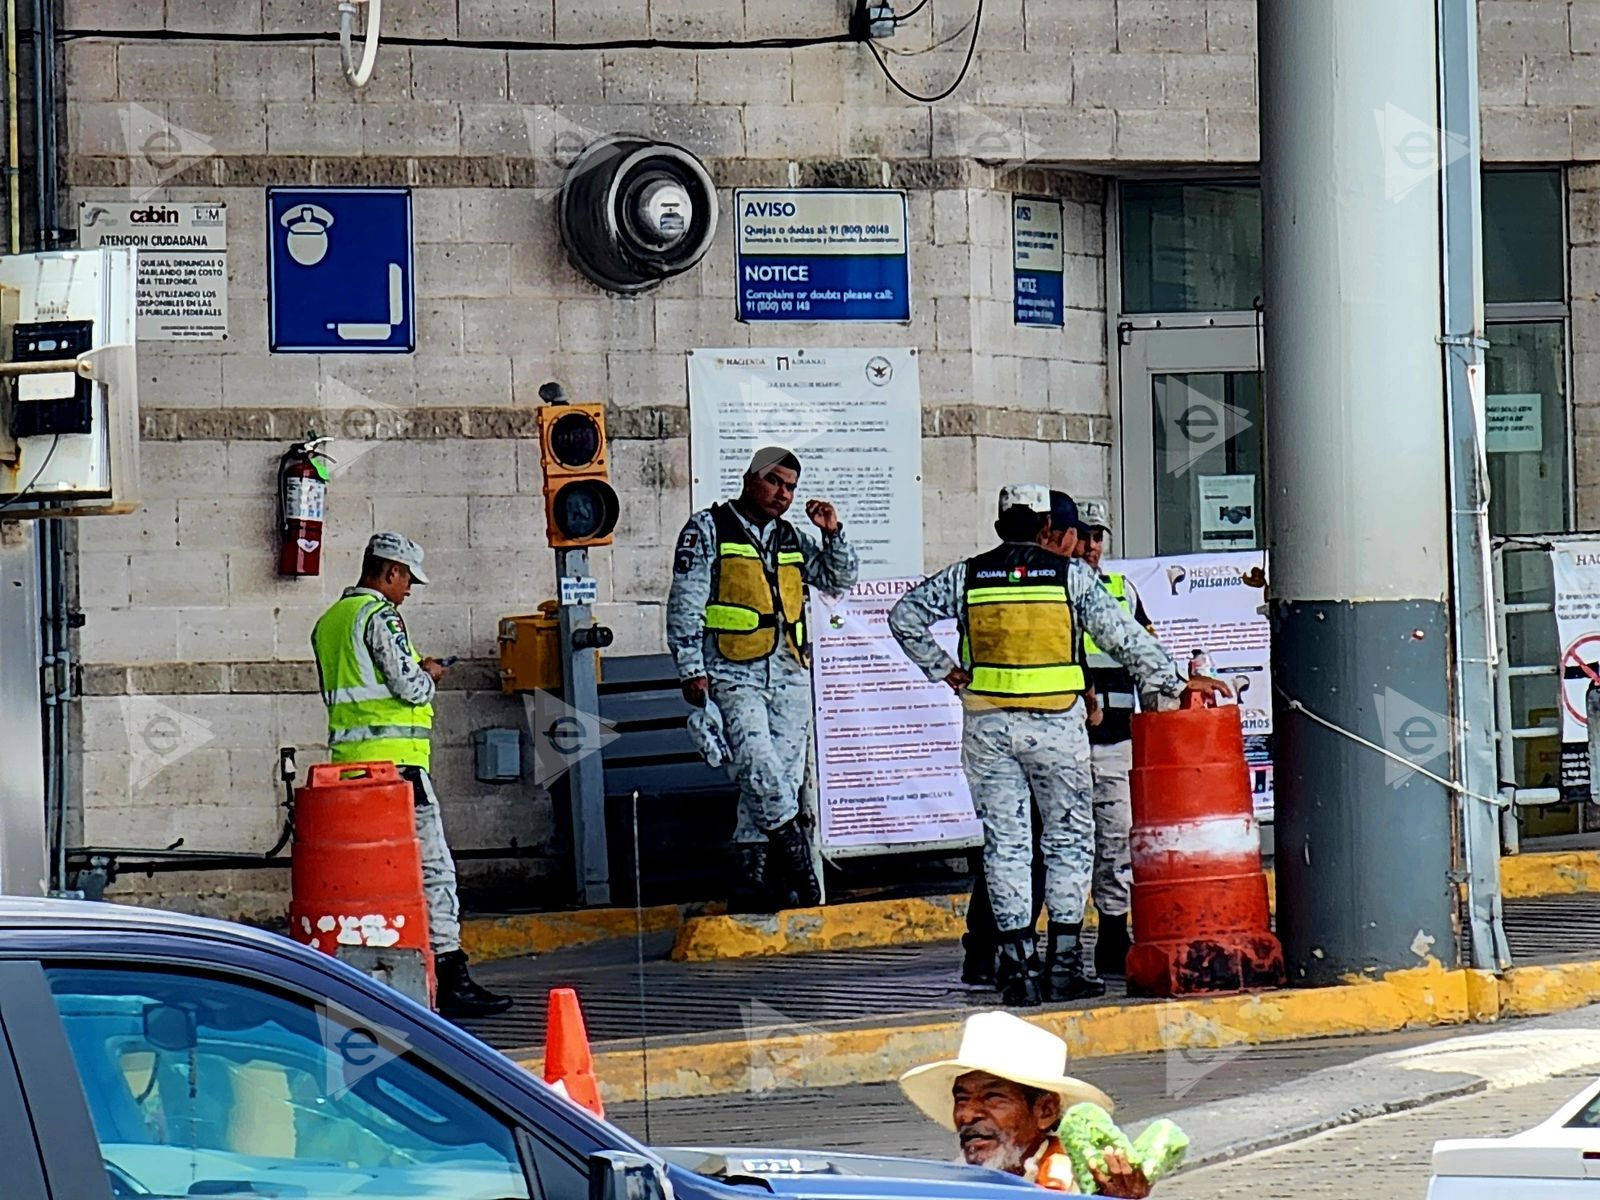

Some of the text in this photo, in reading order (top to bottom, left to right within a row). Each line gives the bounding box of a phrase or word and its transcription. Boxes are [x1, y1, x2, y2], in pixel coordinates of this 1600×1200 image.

[130, 206, 179, 223] cabin
[745, 202, 796, 217] AVISO
[744, 224, 776, 236] Quejas
[787, 225, 814, 234] dudas
[830, 225, 838, 234] 91
[99, 235, 207, 246] ATENCION CIUDADANA
[745, 266, 809, 281] NOTICE
[746, 289, 794, 300] Complains
[810, 289, 841, 299] doubts
[843, 289, 872, 302] please
[746, 301, 755, 311] 91
[781, 301, 792, 311] 00
[796, 301, 810, 311] 148
[1189, 576, 1242, 593] paisanos
